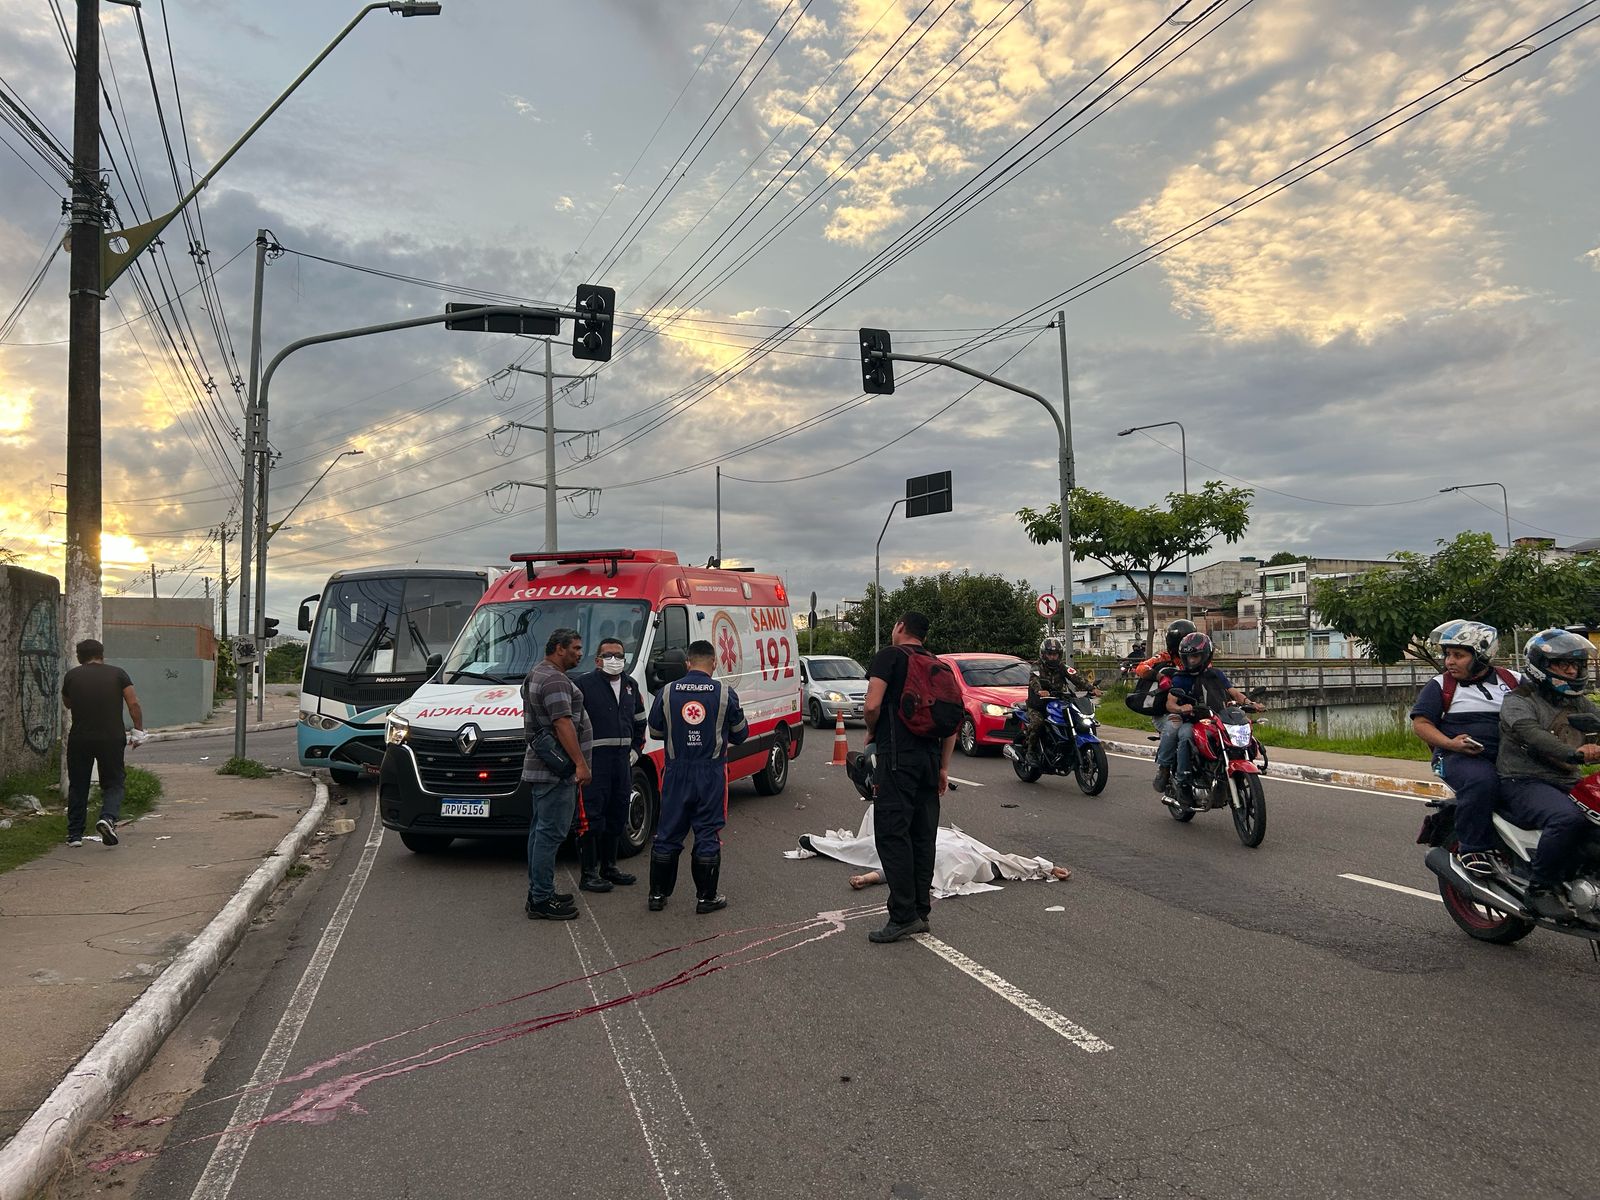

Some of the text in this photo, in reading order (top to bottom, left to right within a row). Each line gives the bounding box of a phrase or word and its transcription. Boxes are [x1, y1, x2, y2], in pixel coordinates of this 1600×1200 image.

[751, 607, 787, 632] SAMU
[756, 636, 794, 682] 192
[675, 683, 715, 691] ENFERMEIRO
